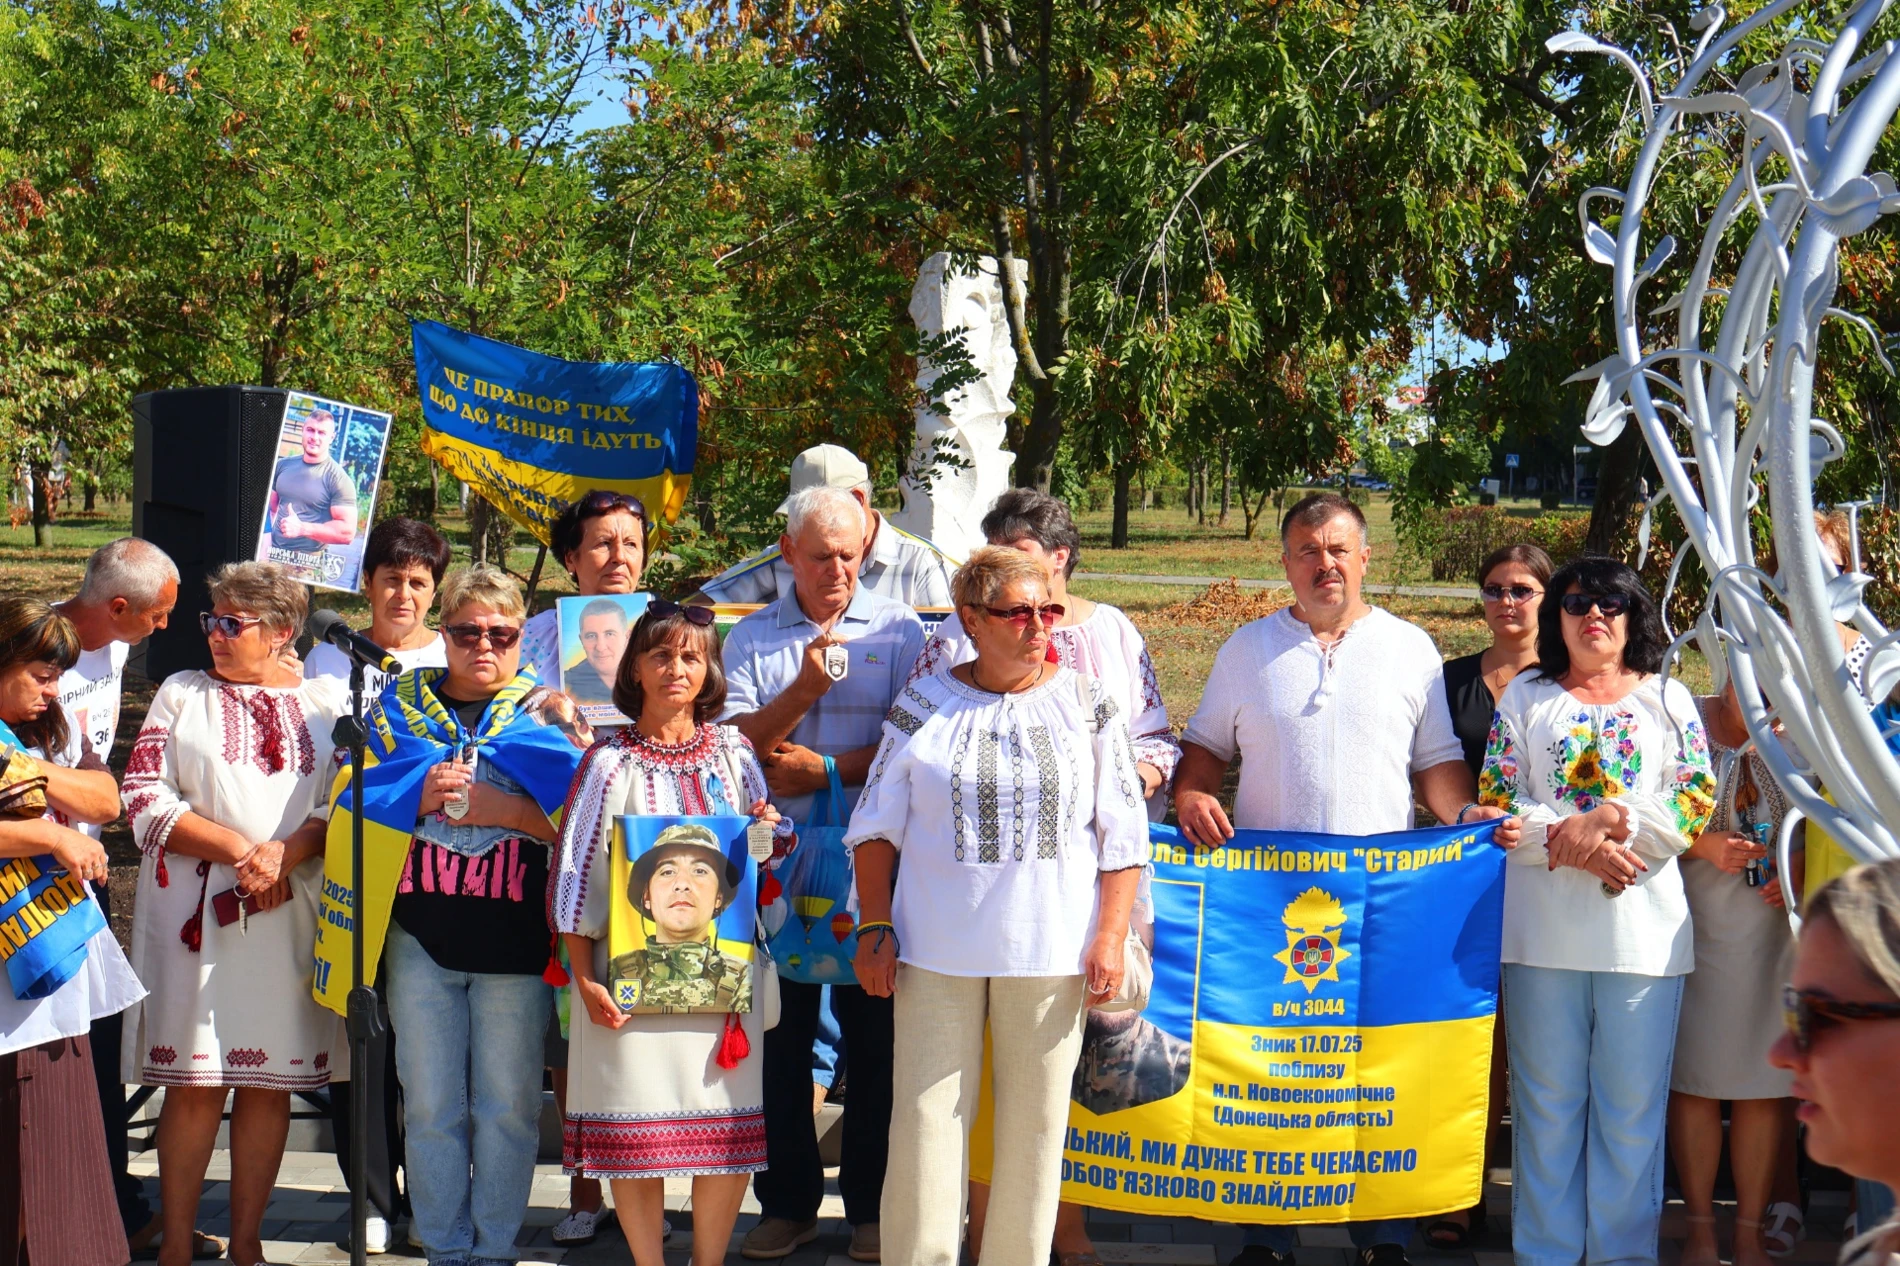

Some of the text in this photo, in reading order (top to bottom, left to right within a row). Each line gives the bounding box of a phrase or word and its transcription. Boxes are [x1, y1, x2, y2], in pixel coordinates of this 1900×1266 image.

[430, 384, 457, 412] ЩО
[460, 403, 490, 424] ДО
[495, 413, 574, 444] КІНЦЯ
[474, 379, 570, 415] ПРАПОР
[576, 402, 636, 425] ТИХ,
[1194, 843, 1347, 872] Сергійович
[1353, 835, 1475, 873] "Старий"
[1272, 998, 1345, 1017] в/ч 3044
[1251, 1035, 1363, 1053] Зник 17.07.25
[1268, 1061, 1346, 1079] поблизу
[1213, 1083, 1395, 1104] н.п. Новоекономічне
[1213, 1105, 1393, 1130] (Донецька область)
[1140, 1139, 1177, 1166] МИ
[1181, 1144, 1248, 1173] ДУЖЕ
[1252, 1150, 1306, 1176] ТЕБЕ
[1311, 1148, 1418, 1175] ЧЕКАЄМО
[1061, 1158, 1357, 1211] ОБОВ'ЯЗКОВО ЗНАЙДЕМО!
